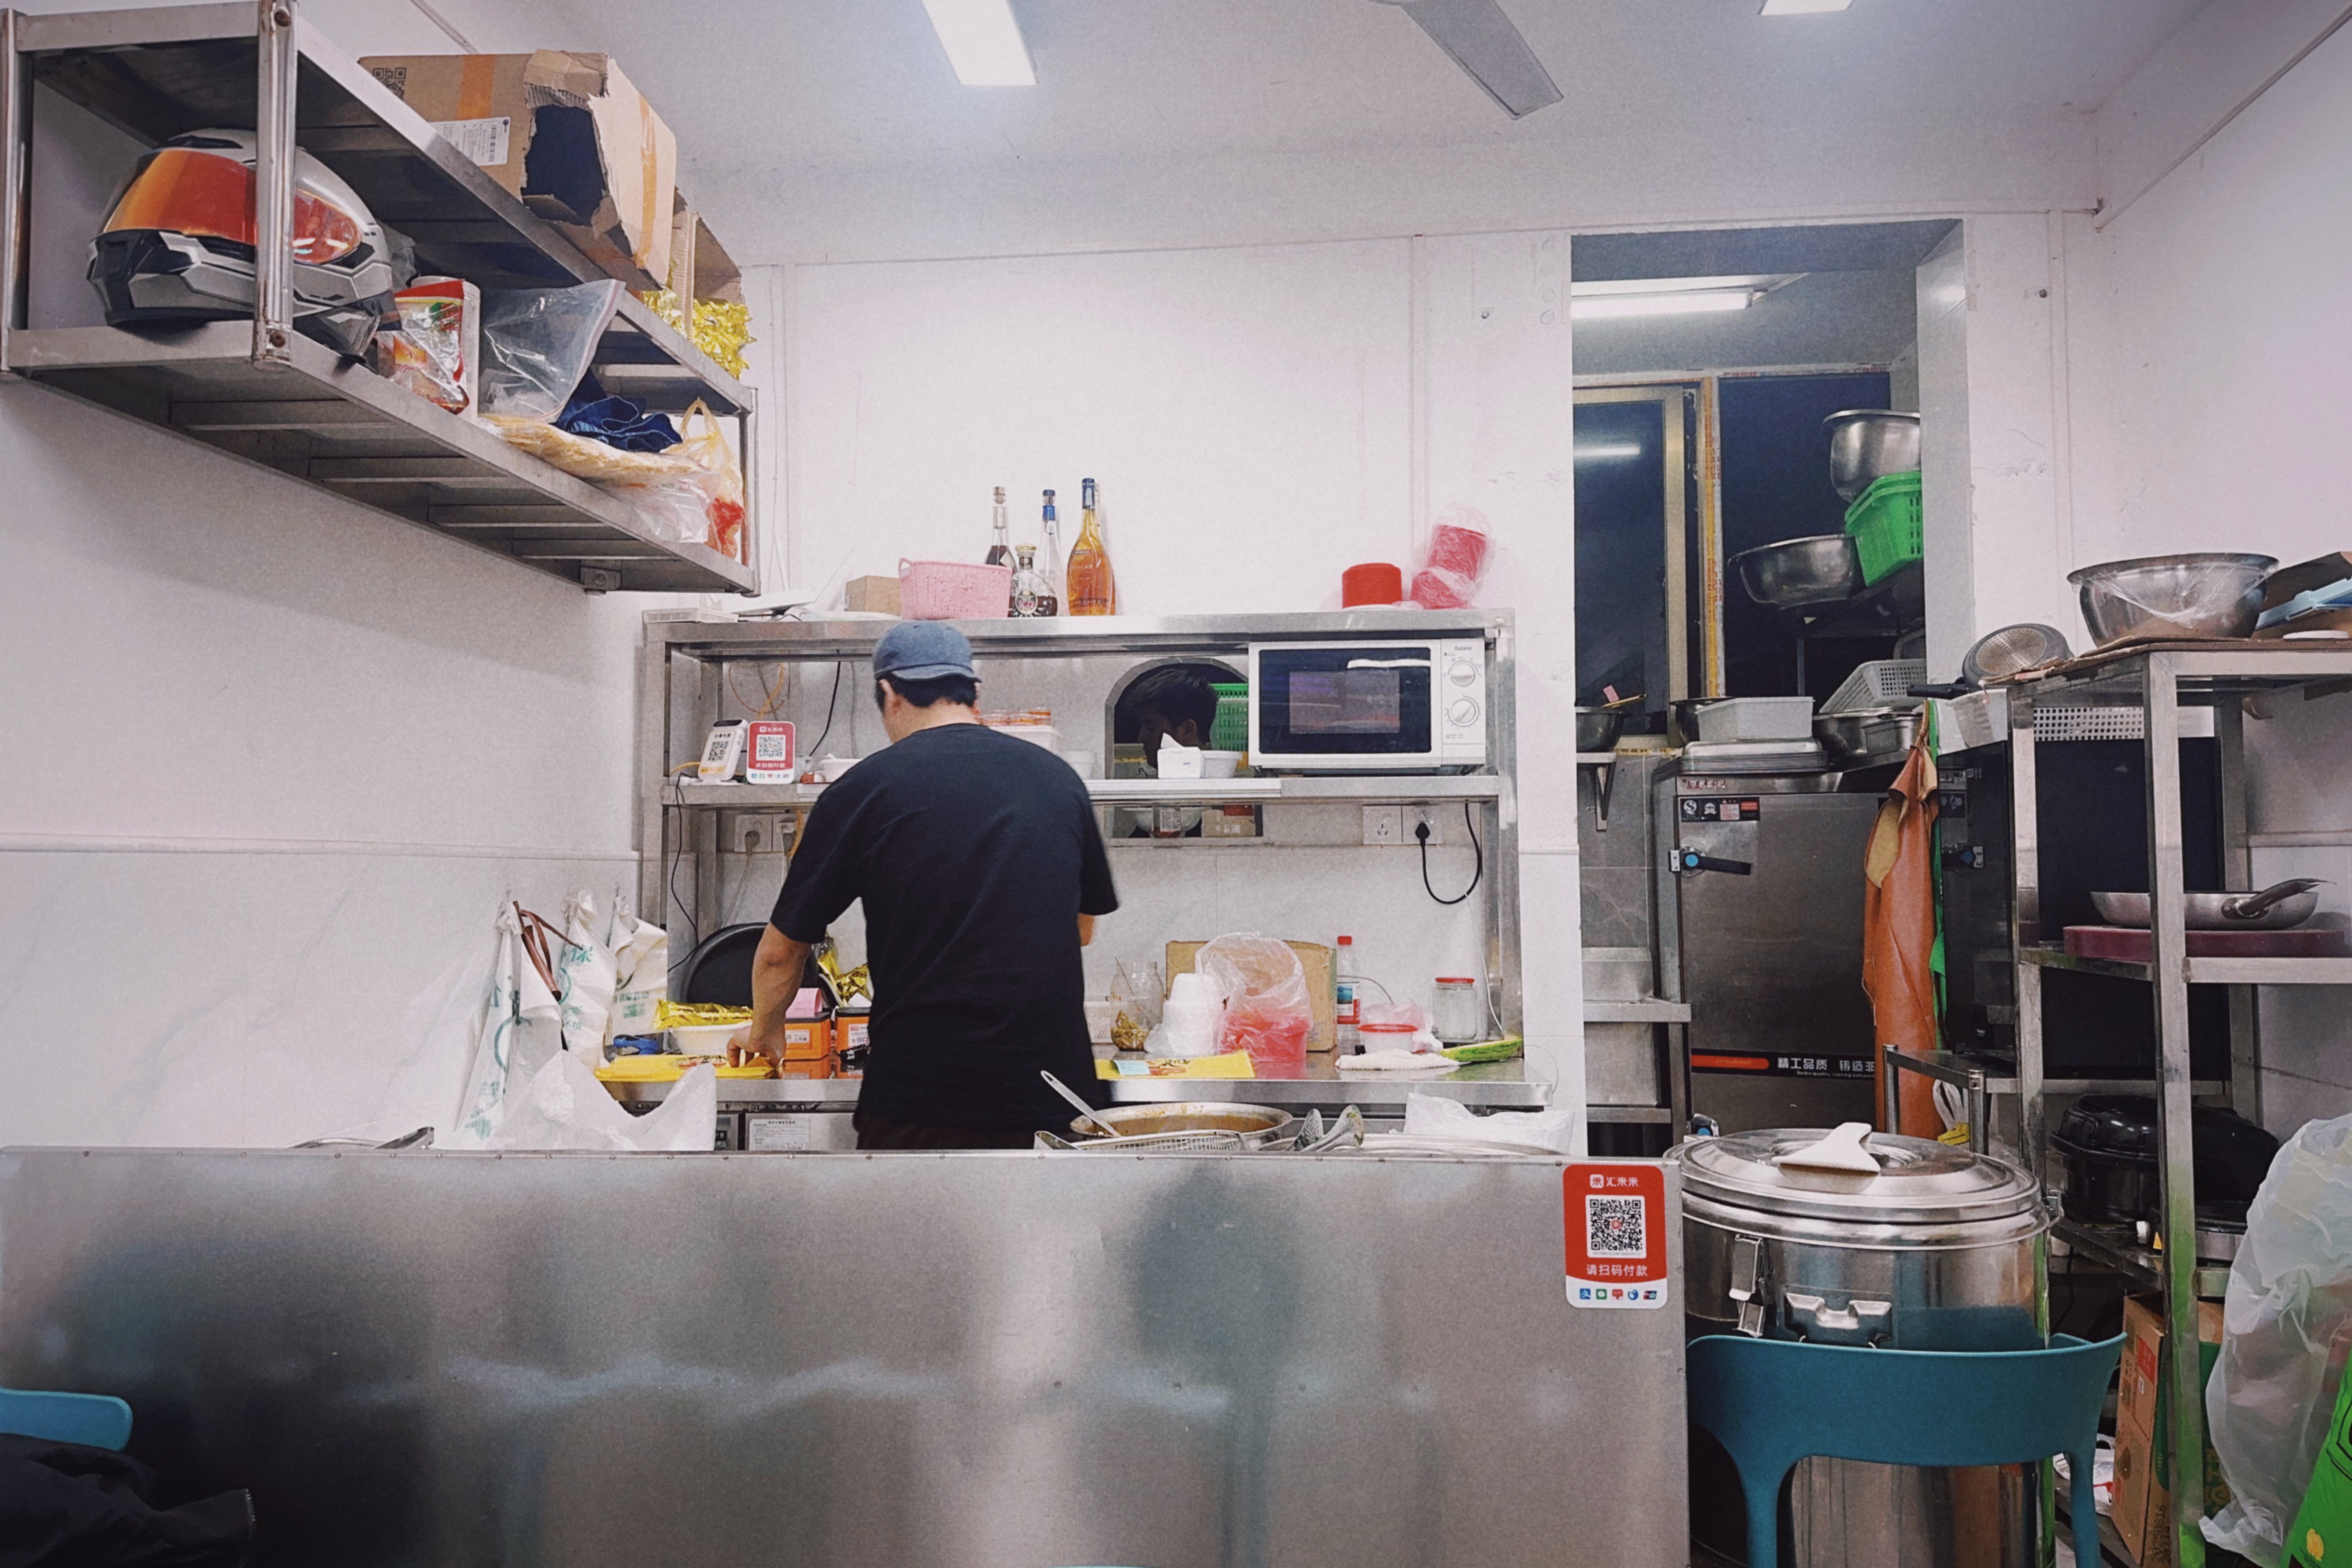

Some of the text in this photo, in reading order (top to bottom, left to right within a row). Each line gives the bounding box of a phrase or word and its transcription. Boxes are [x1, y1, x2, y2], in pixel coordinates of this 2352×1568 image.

[1777, 1058, 1828, 1070] 精工品质
[1586, 1264, 1648, 1277] 请扫码付款
